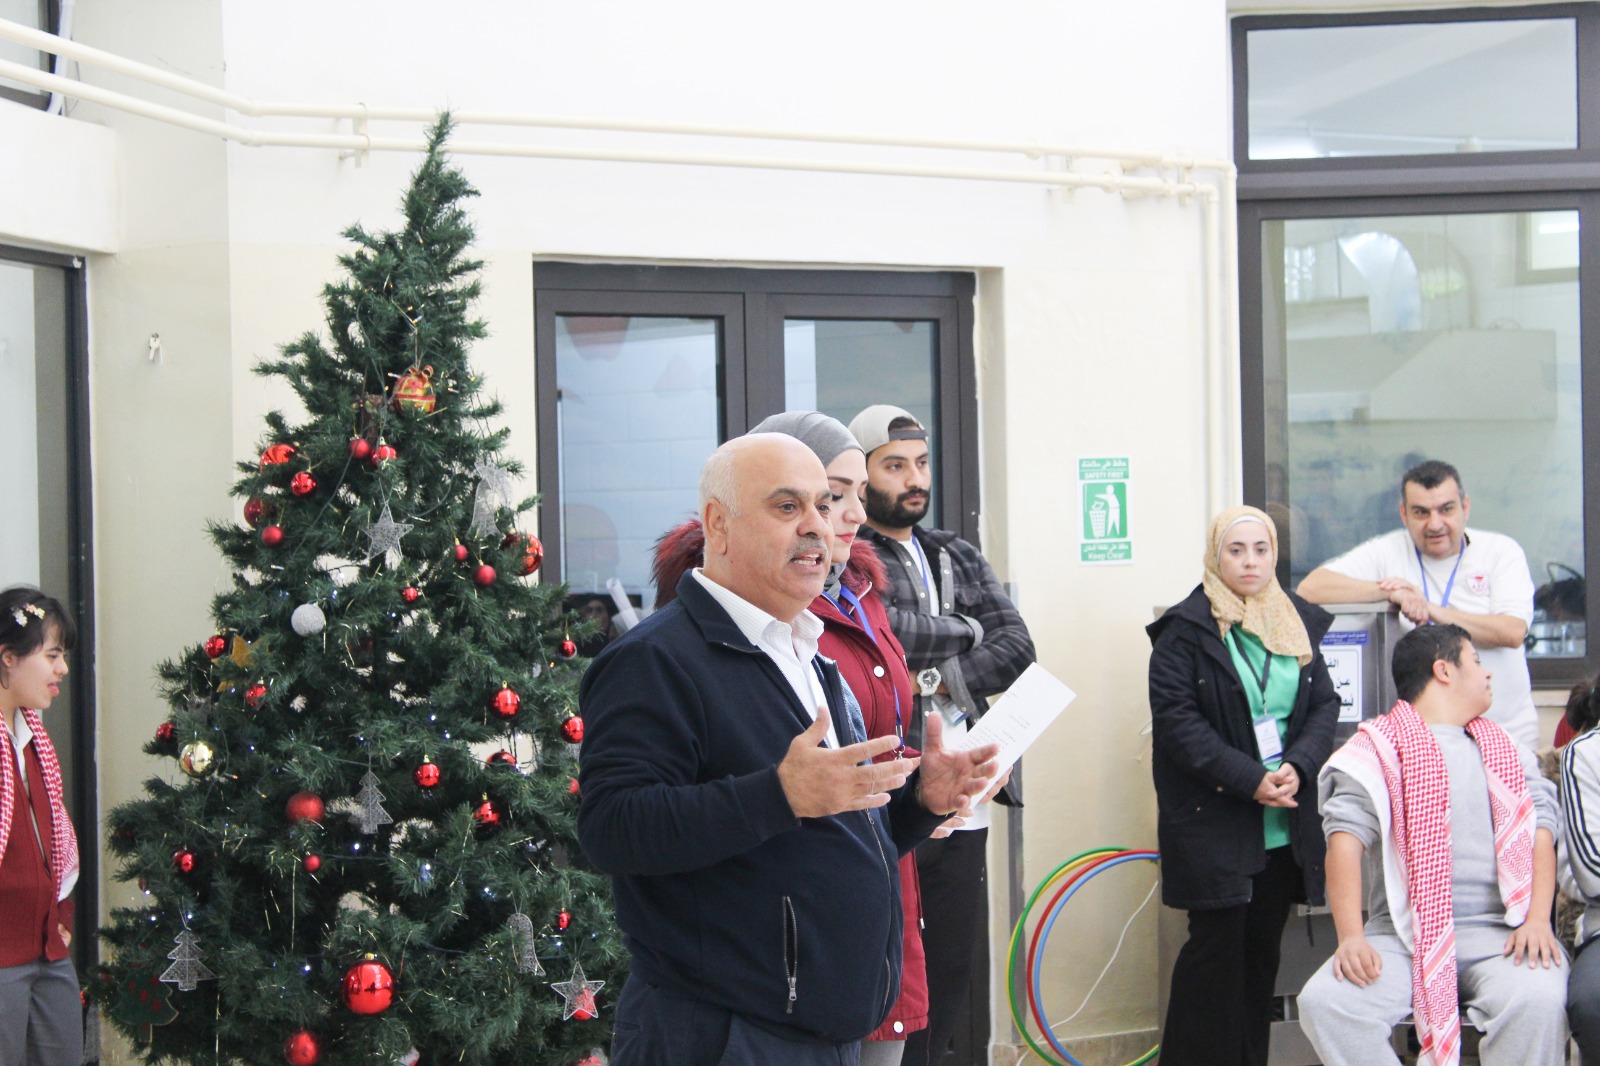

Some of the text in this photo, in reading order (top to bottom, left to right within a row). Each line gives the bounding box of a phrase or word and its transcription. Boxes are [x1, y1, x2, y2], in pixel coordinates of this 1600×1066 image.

[1084, 471, 1124, 479] SAFETY FIRST
[1088, 553, 1106, 561] Keep
